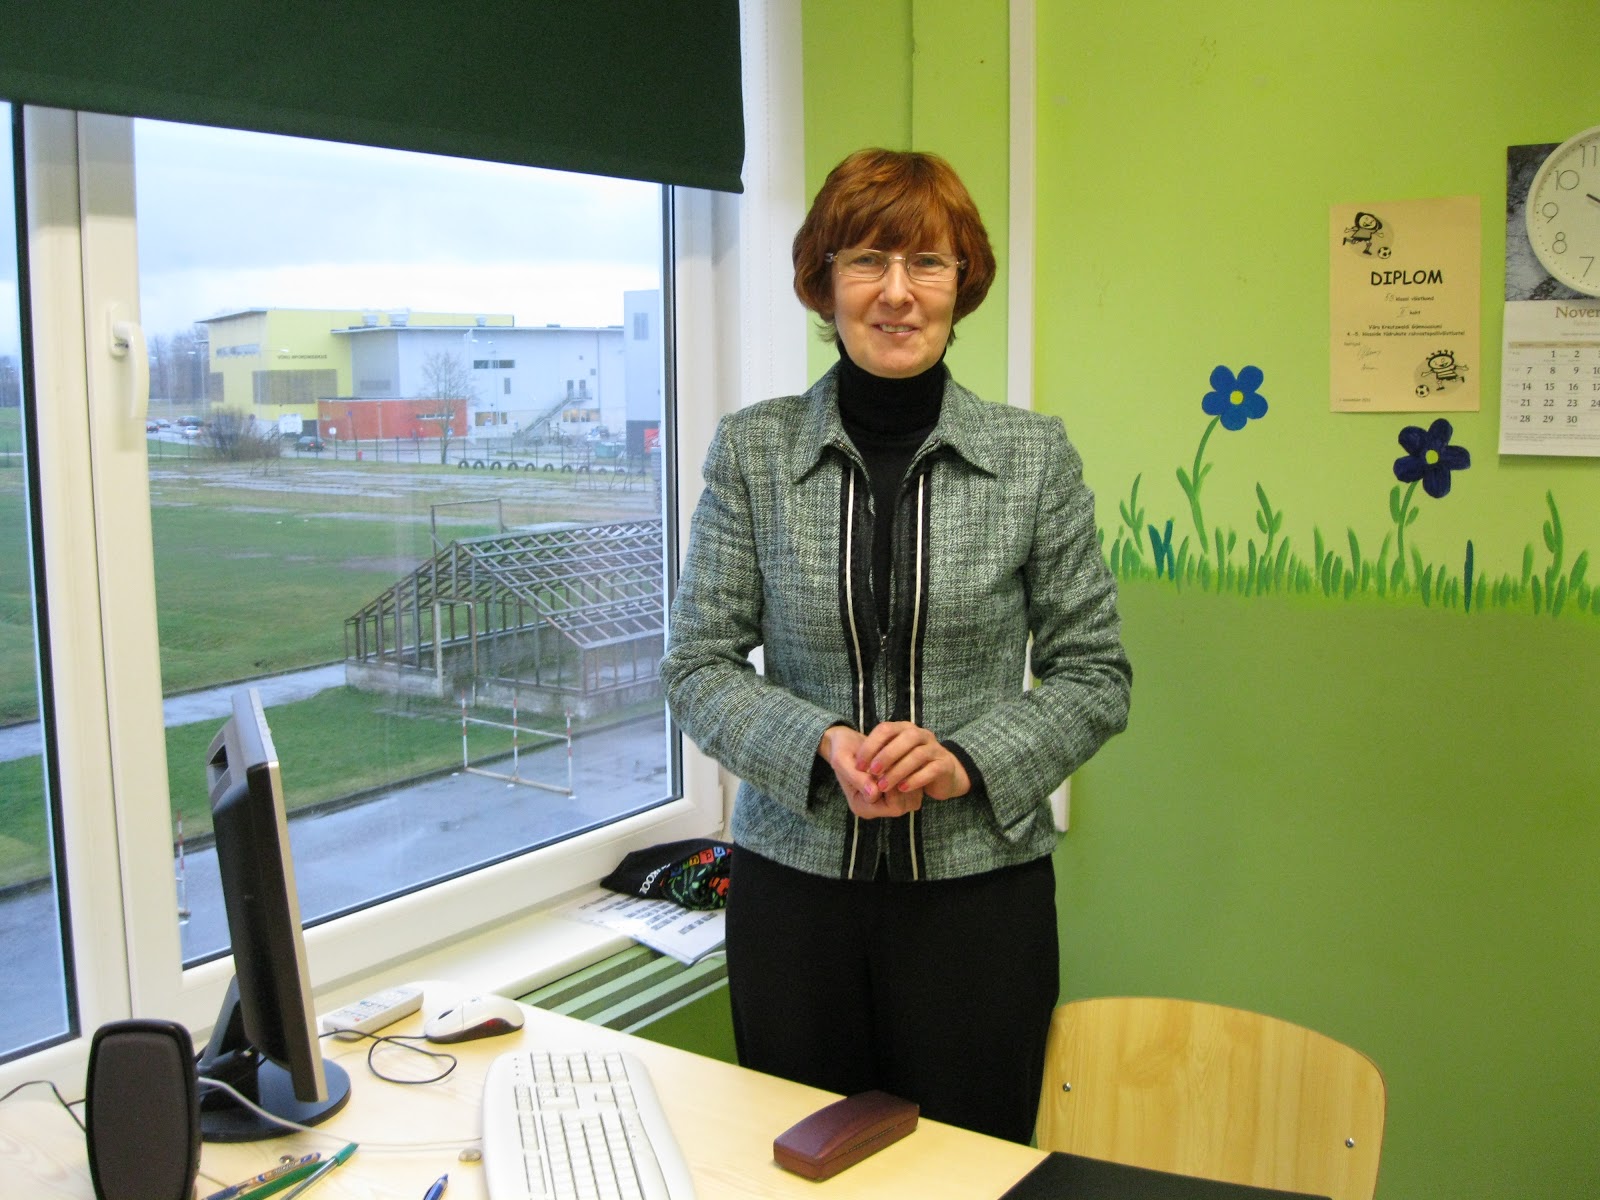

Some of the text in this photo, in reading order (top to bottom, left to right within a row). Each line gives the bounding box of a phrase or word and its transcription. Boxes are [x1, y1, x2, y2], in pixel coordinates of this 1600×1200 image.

[1581, 145, 1597, 168] 11
[1555, 169, 1580, 191] 10
[1541, 201, 1559, 224] 9
[1552, 231, 1567, 254] 8
[1579, 256, 1595, 278] 7
[1371, 269, 1443, 286] DIPLOM
[1551, 350, 1580, 358] 1 2
[1527, 367, 1533, 375] 7
[1550, 367, 1556, 375] 8
[1573, 367, 1579, 375] 9
[1522, 383, 1531, 391] 14
[1545, 383, 1555, 391] 15
[1569, 383, 1579, 391] 16
[1520, 399, 1530, 407] 21
[1543, 399, 1554, 407] 22
[1567, 399, 1578, 407] 23
[1519, 415, 1531, 423] 28
[1542, 415, 1554, 423] 29
[1566, 415, 1578, 424] 30
